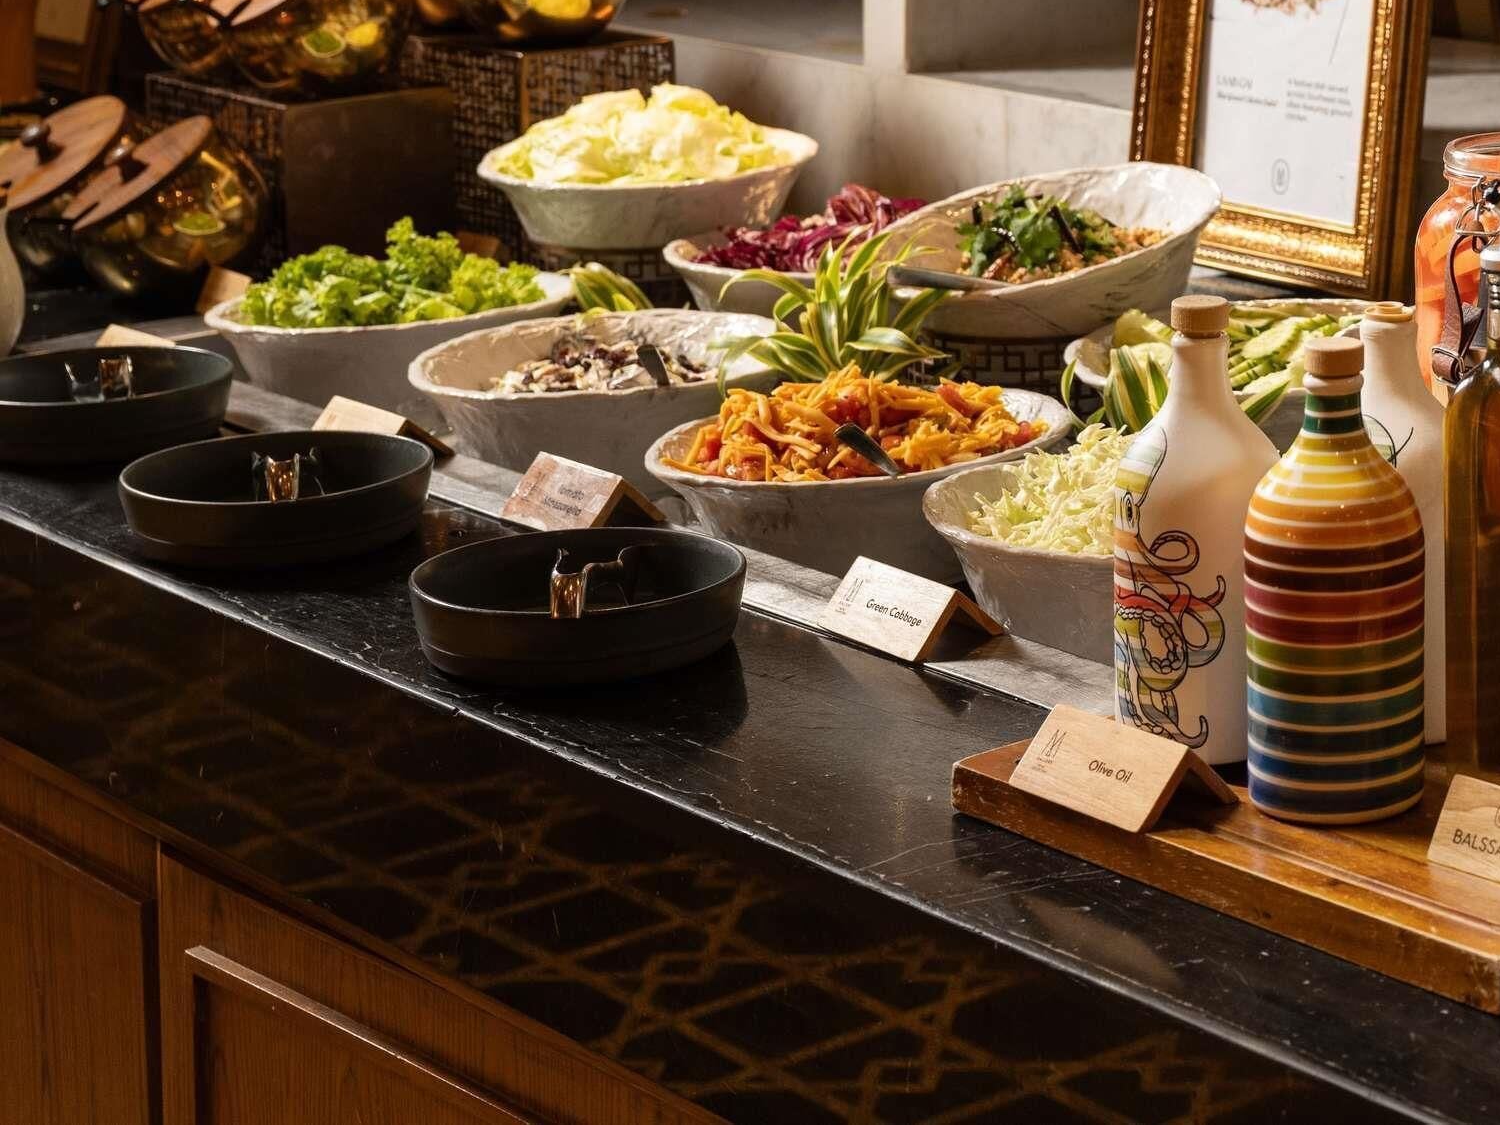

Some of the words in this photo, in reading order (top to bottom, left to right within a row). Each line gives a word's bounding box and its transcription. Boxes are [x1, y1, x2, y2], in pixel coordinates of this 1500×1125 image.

[866, 598, 889, 615] Green
[889, 607, 922, 627] Cabbage
[1088, 760, 1114, 776] Olive
[1115, 769, 1133, 783] Oil
